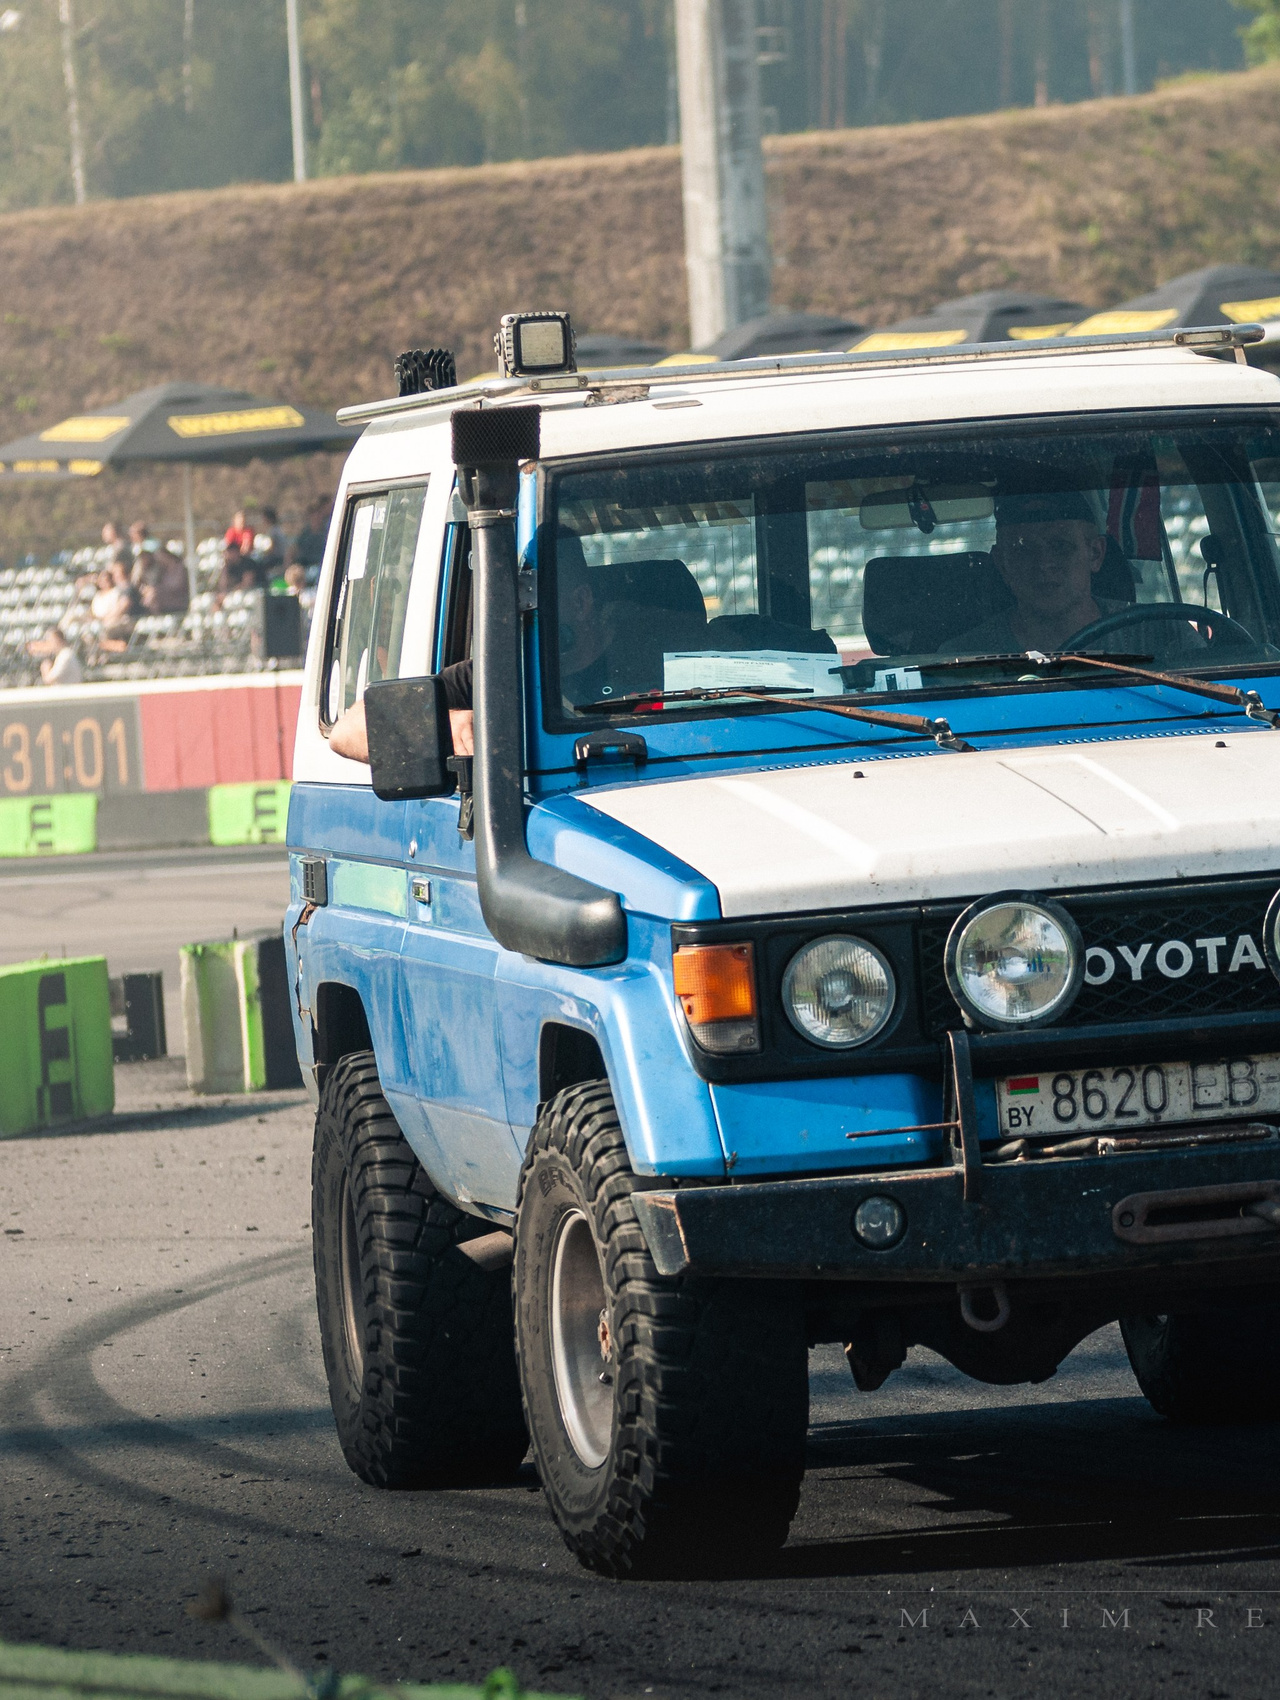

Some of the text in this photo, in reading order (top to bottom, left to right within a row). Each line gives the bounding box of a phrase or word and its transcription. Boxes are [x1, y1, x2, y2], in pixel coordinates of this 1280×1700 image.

[3, 717, 129, 792] 31:01
[1084, 934, 1266, 985] OYOTA
[1007, 1105, 1035, 1129] BY
[1051, 1063, 1168, 1124] 8620
